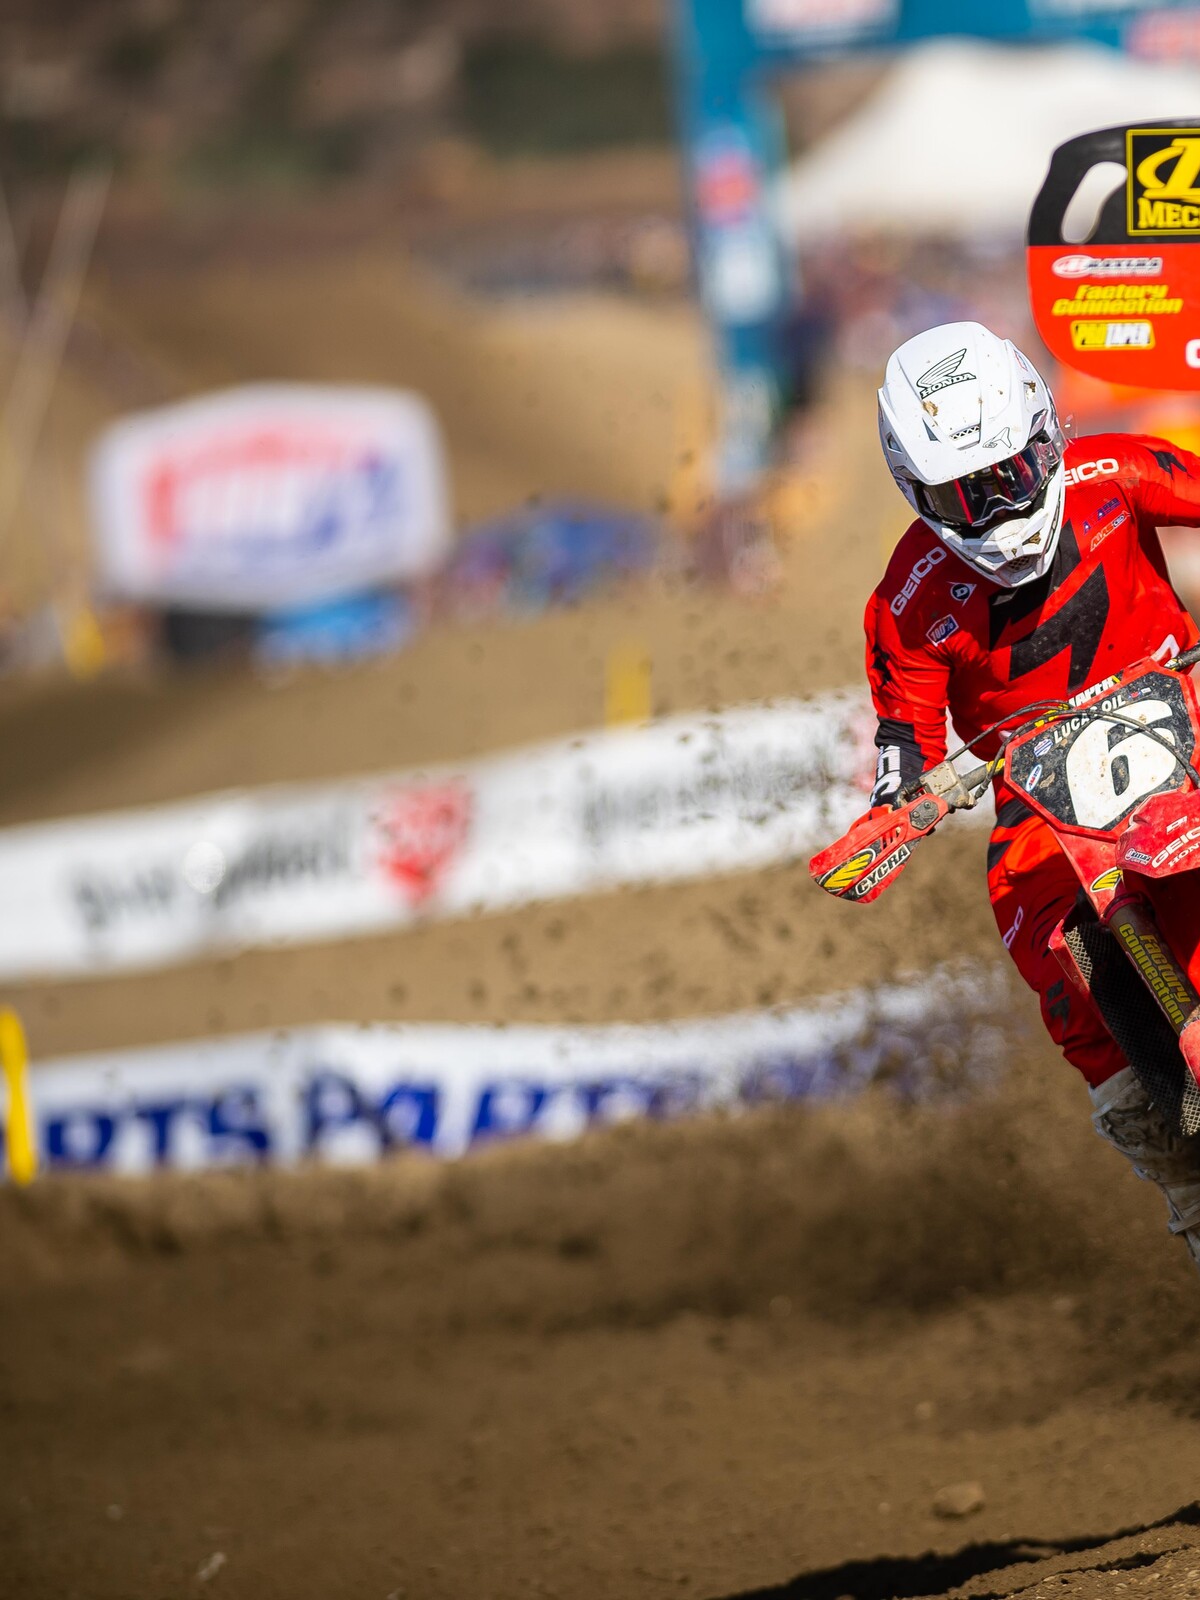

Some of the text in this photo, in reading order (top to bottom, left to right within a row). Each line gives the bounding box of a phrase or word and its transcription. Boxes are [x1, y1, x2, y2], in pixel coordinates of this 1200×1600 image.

[1074, 284, 1169, 300] Factory
[1052, 298, 1183, 316] Connection
[920, 373, 976, 399] HONDA
[1065, 458, 1120, 487] EICO
[890, 546, 947, 616] GEICO
[930, 620, 954, 641] 100%
[1101, 694, 1126, 712] OIL
[1065, 699, 1177, 830] 6
[854, 843, 911, 896] CYCRA
[1119, 923, 1185, 1025] Connection
[1139, 934, 1192, 1003] Factory
